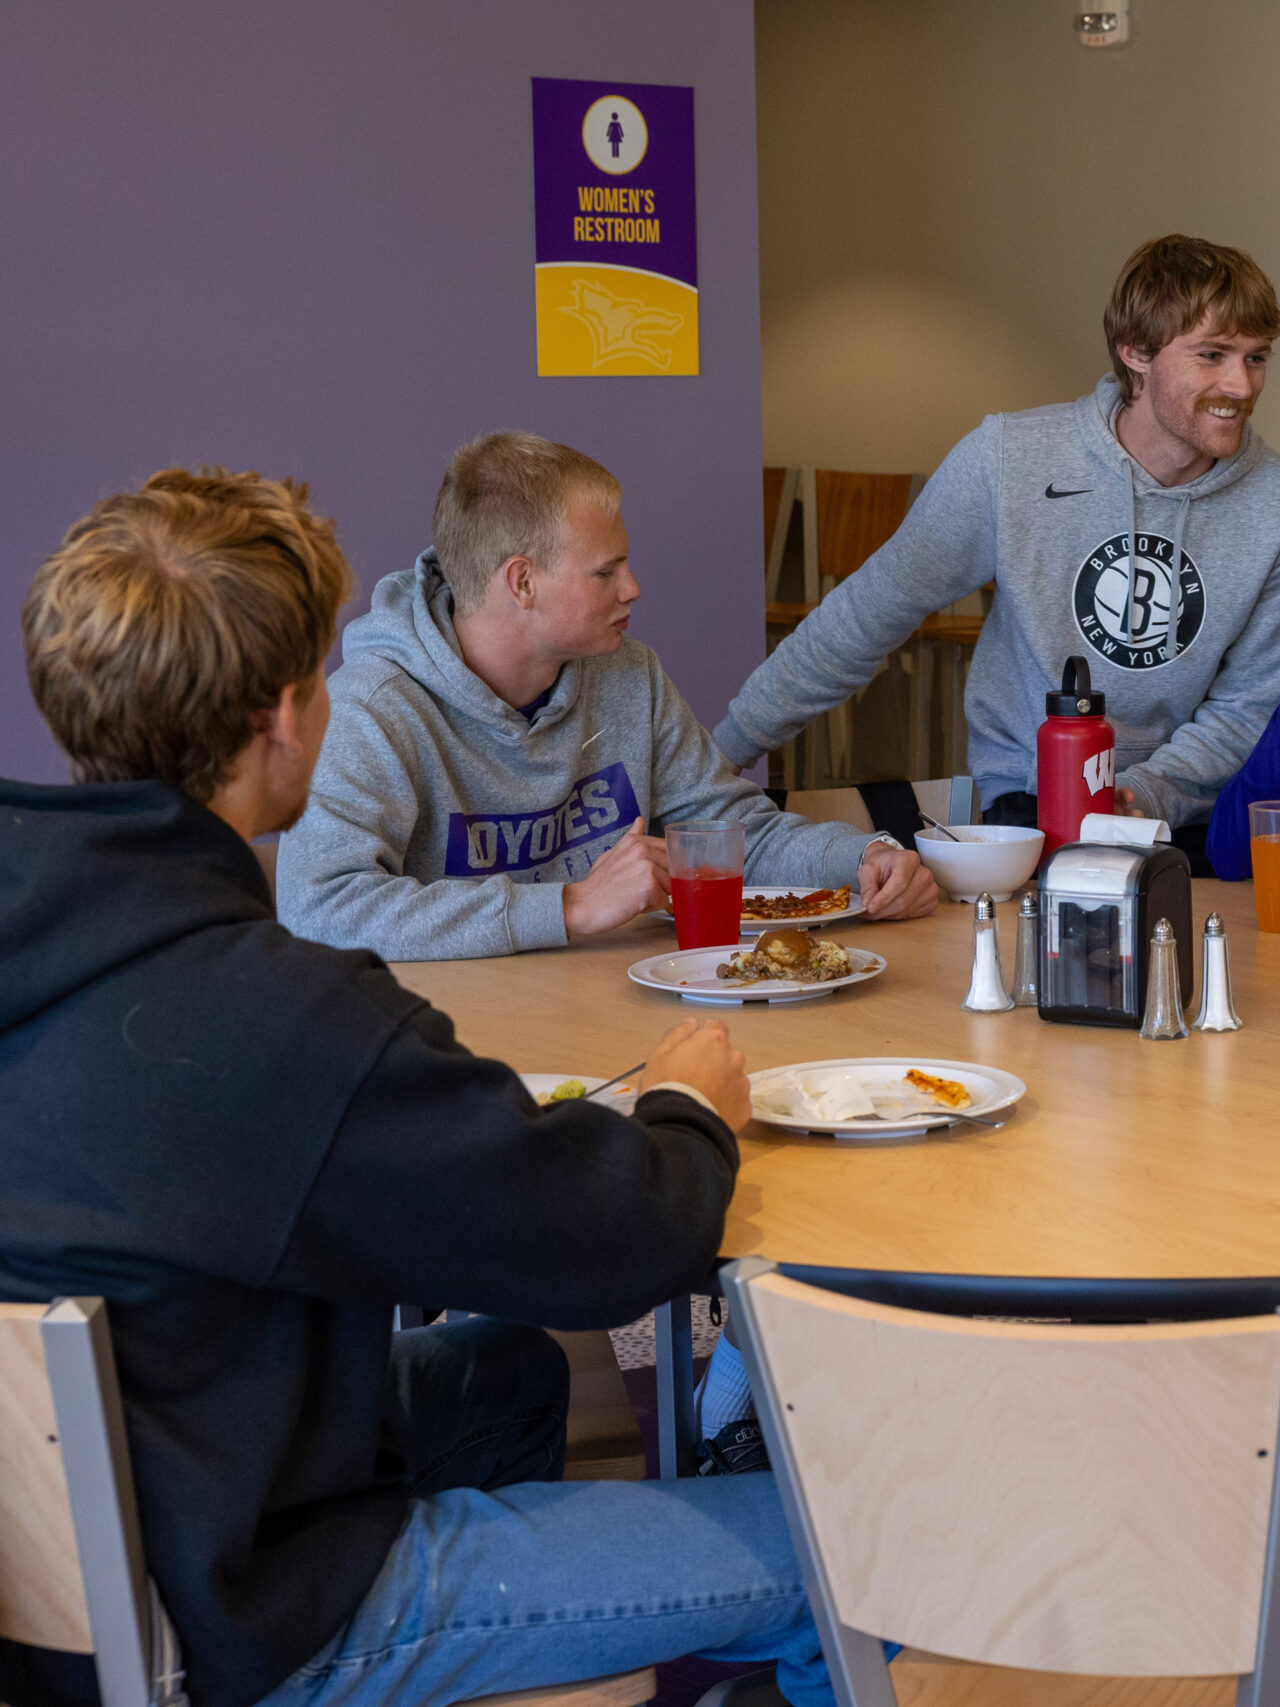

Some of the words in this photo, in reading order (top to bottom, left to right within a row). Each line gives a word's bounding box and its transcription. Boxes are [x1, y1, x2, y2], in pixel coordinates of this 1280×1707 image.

[577, 186, 655, 214] WOMEN'S
[573, 216, 661, 243] RESTROOM
[1089, 537, 1200, 595] BROOKYN
[1081, 614, 1118, 655] NEW
[466, 778, 621, 870] OYOTES
